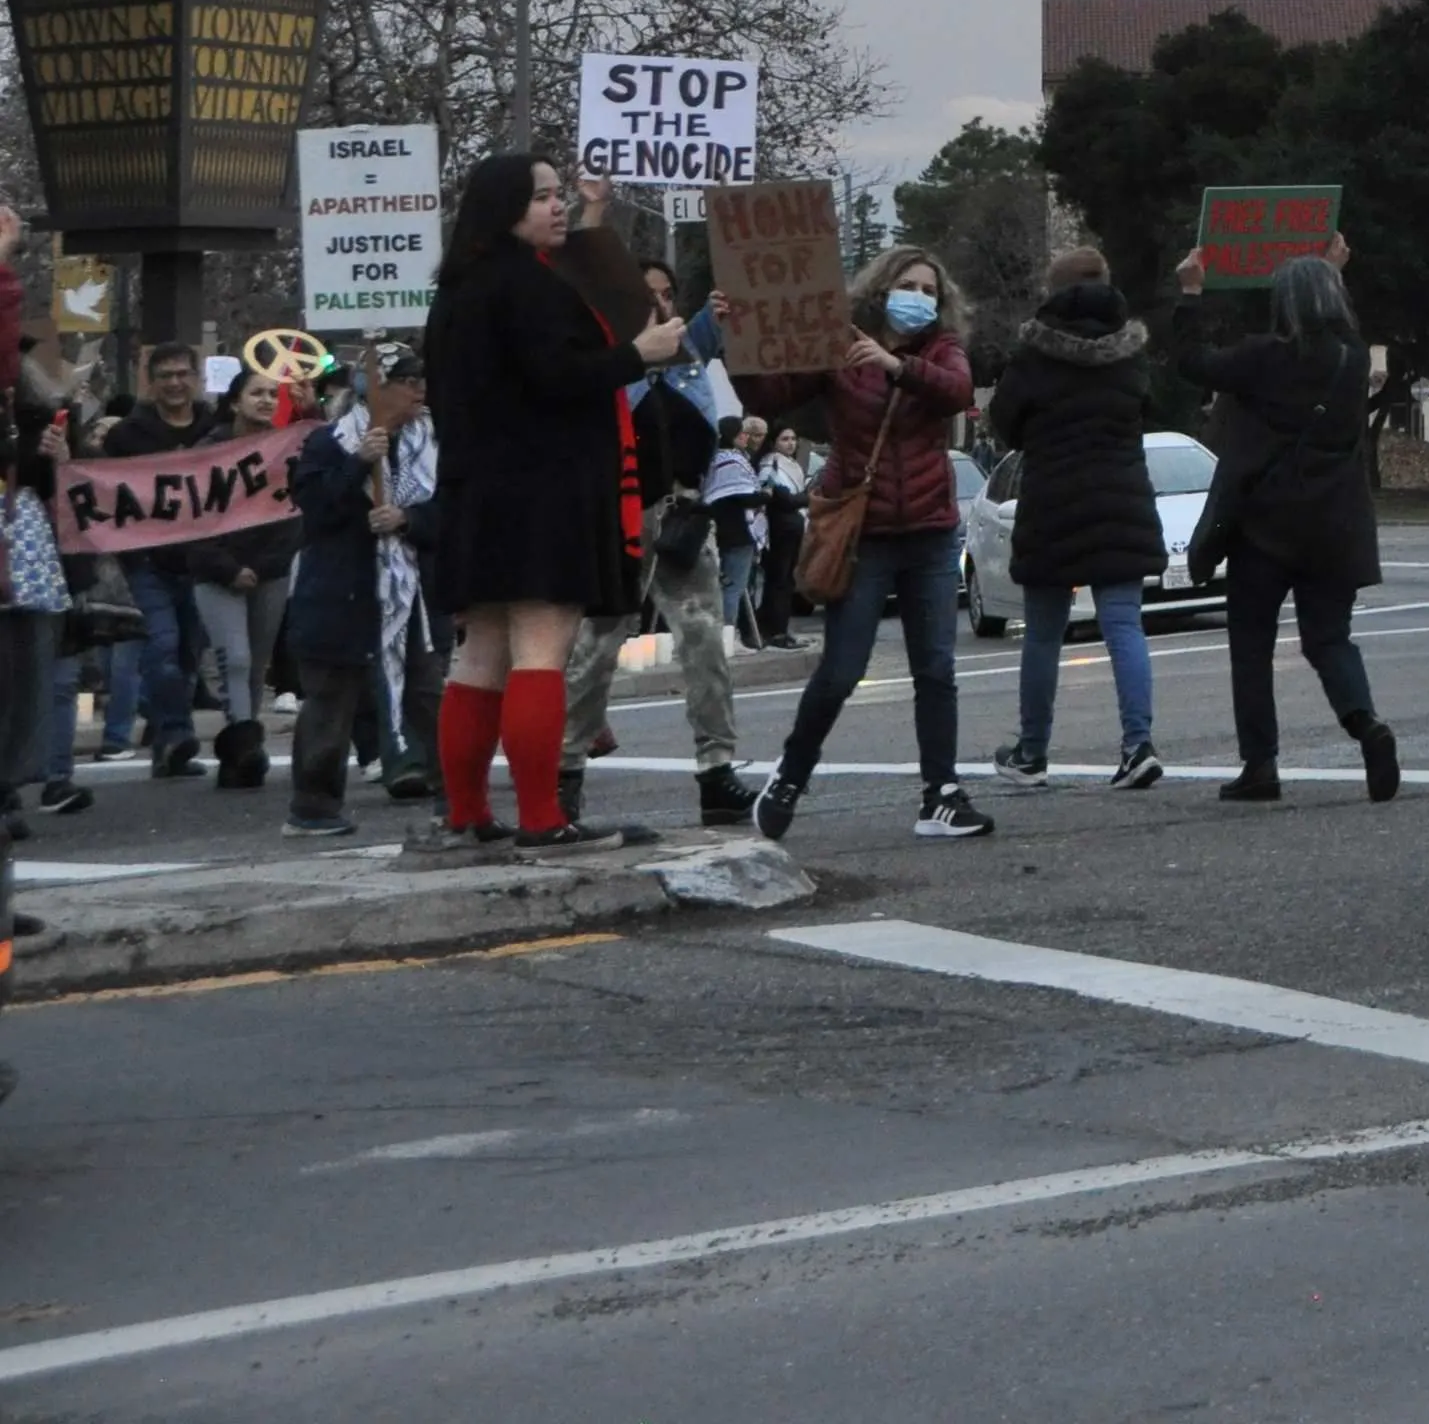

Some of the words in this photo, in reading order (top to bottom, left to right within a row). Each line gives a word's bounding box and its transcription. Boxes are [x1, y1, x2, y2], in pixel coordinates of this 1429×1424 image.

[35, 7, 132, 47] TOWN
[193, 6, 282, 46] TOWN
[39, 45, 171, 82] COUNTRY
[195, 45, 306, 86] COUNTRY
[43, 81, 172, 126] VILLAGE
[193, 84, 300, 124] VILLAGE
[602, 64, 748, 109] STOP
[621, 111, 711, 137] THE
[329, 139, 412, 159] ISRAEL
[584, 138, 753, 182] GENOCIDE
[308, 194, 438, 216] APARTHEID
[713, 187, 839, 244] HONK
[1209, 198, 1267, 234] FREE
[1274, 198, 1331, 233] FREE
[326, 234, 423, 254] JUSTICE
[352, 263, 399, 281] FOR
[741, 247, 814, 289] FOR
[727, 290, 844, 336] PEACE
[67, 451, 268, 532] RAGING
